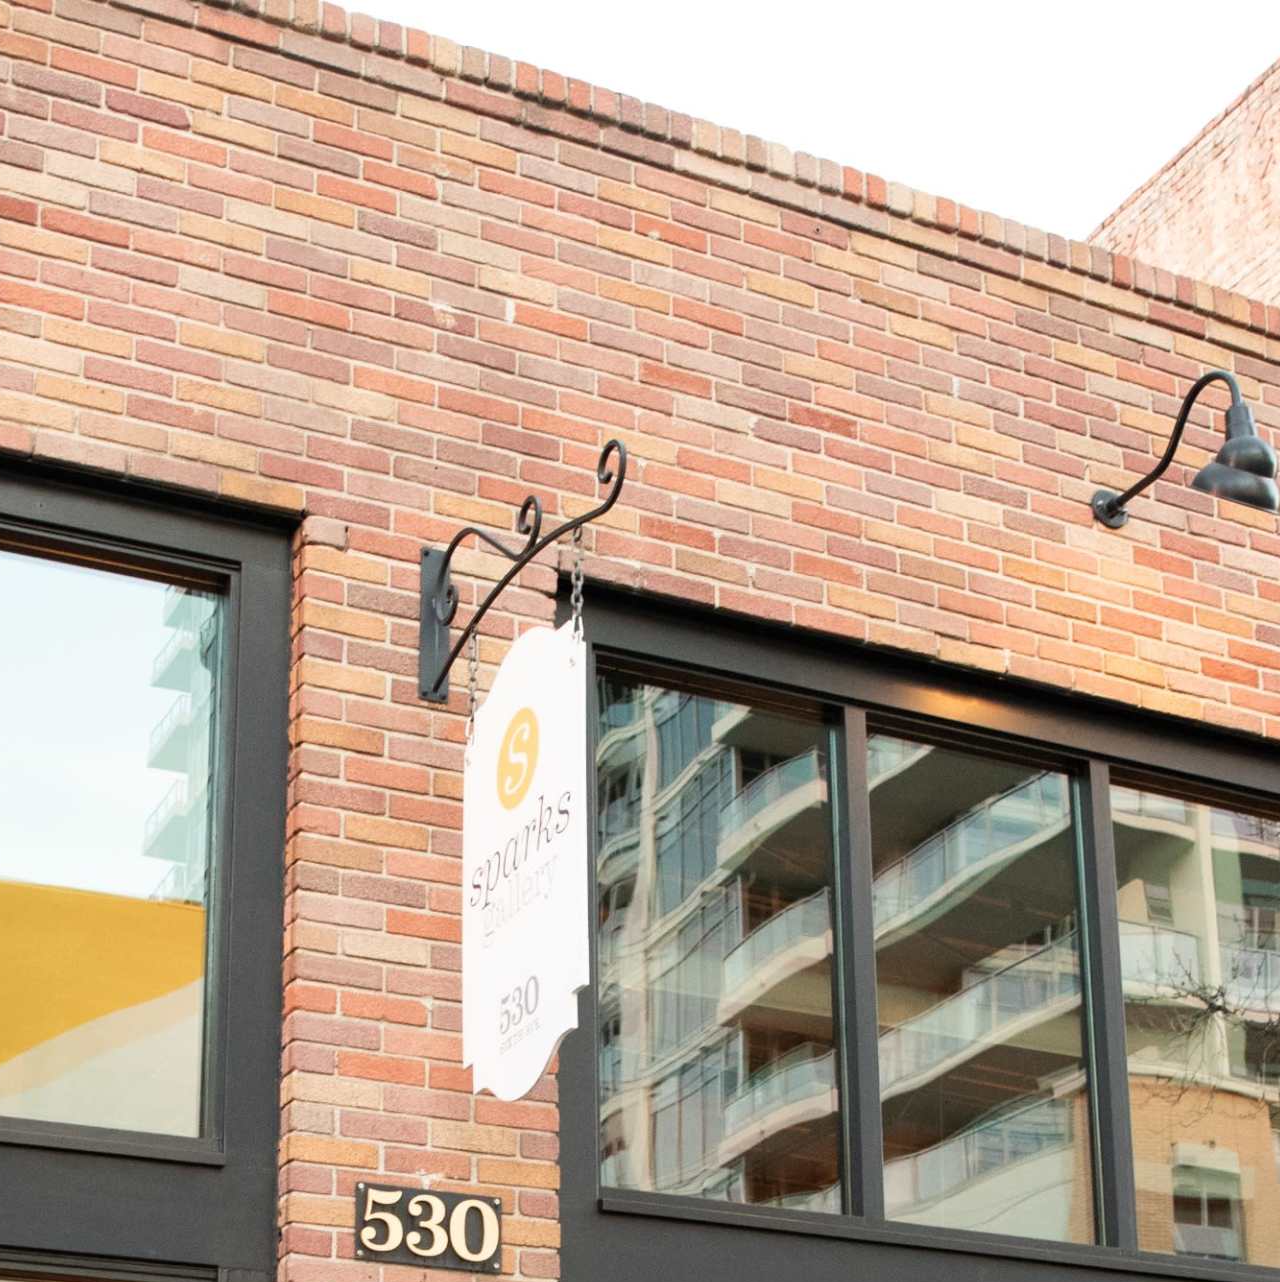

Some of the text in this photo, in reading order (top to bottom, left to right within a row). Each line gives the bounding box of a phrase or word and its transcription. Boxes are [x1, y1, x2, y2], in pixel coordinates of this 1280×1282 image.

[470, 791, 571, 910] sparks
[499, 974, 540, 1035] 530
[361, 1190, 500, 1263] 530
